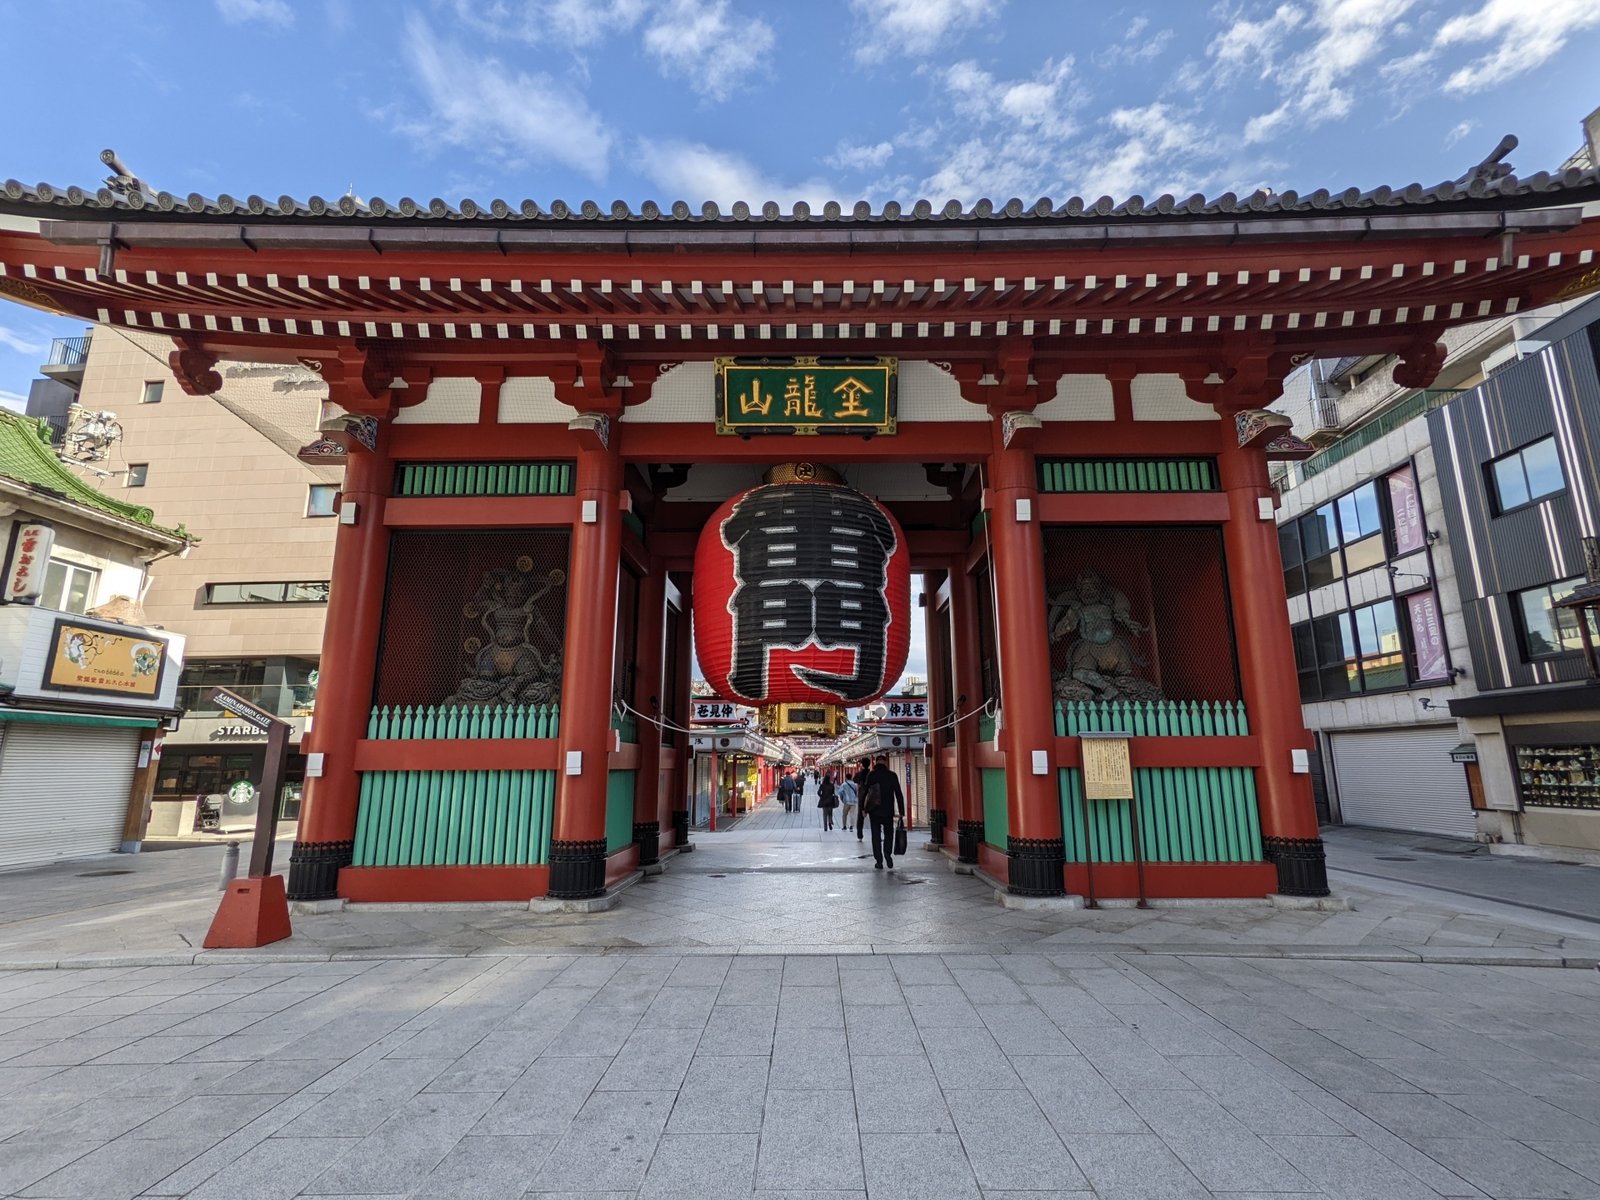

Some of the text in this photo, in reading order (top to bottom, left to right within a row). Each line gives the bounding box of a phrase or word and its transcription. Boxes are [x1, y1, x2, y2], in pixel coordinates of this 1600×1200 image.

[720, 483, 898, 701] 雷門
[218, 692, 257, 718] KAMINARIMON
[255, 713, 272, 725] GATE
[217, 725, 296, 736] STARBS
